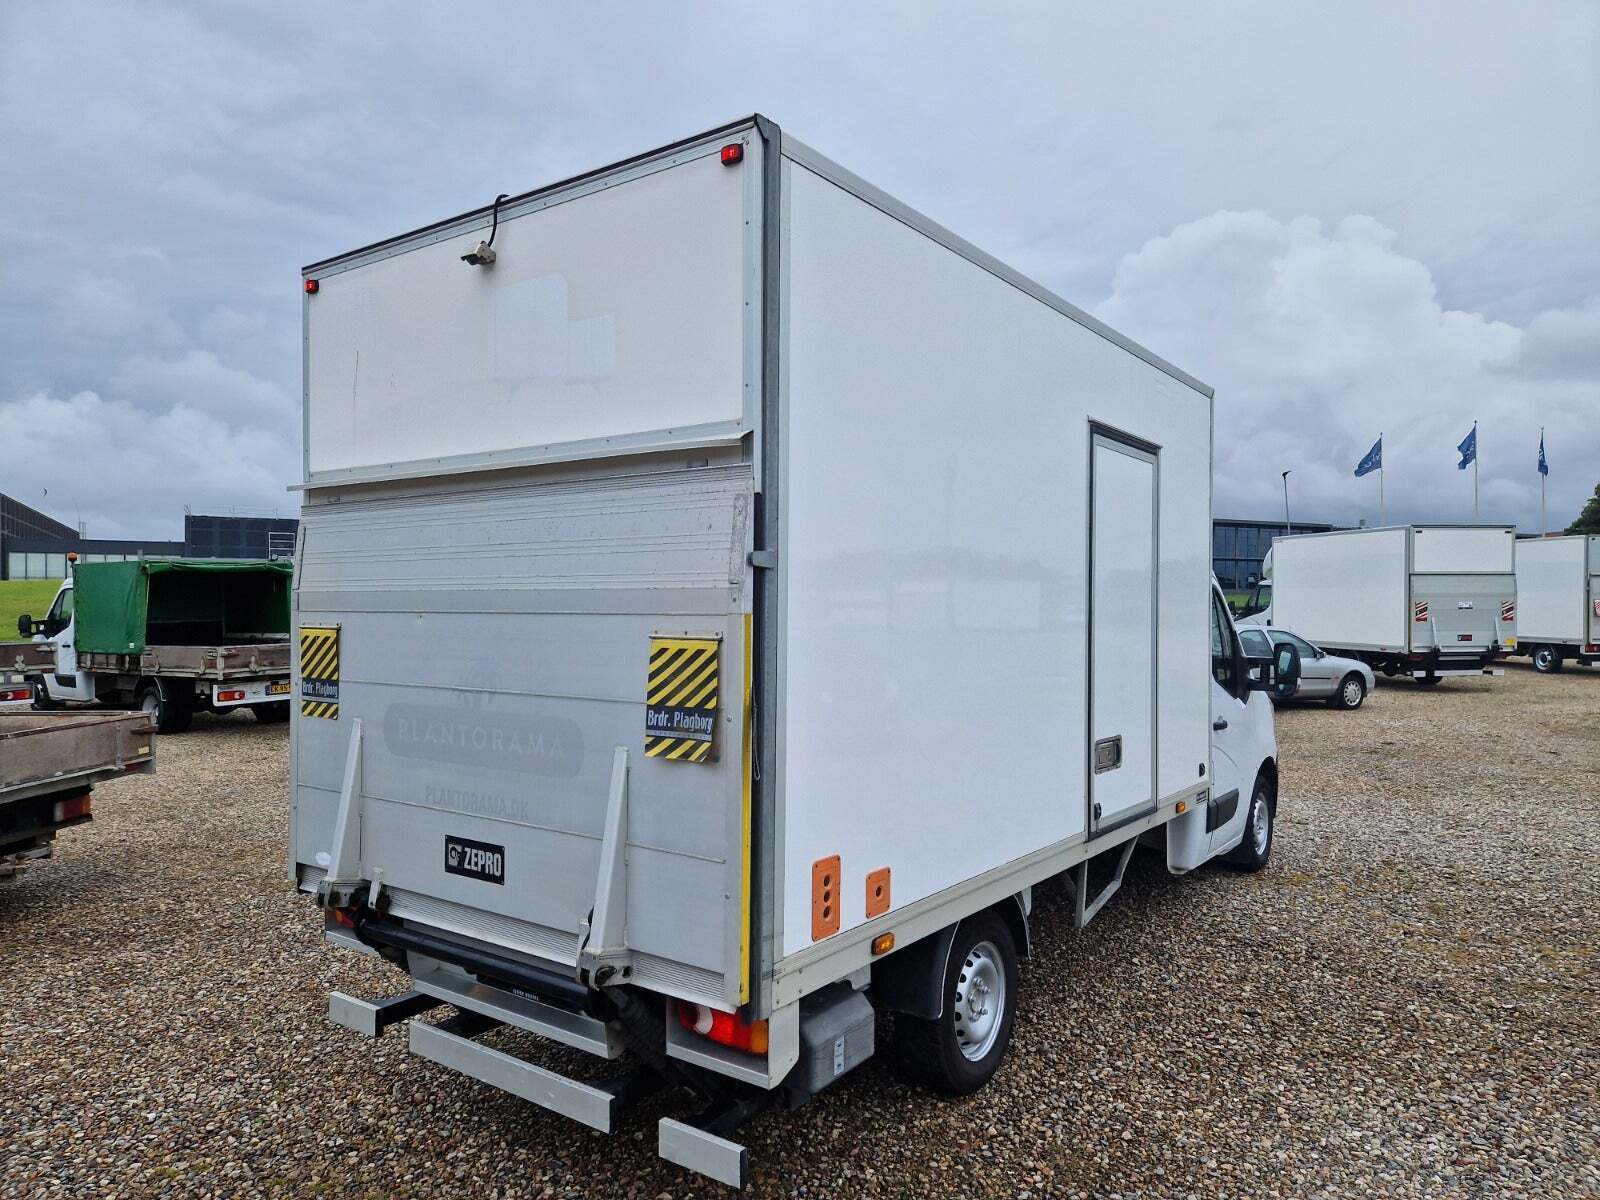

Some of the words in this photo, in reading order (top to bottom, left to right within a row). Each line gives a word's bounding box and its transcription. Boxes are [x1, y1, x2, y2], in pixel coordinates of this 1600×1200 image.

[647, 709, 671, 727] Brdr.
[673, 711, 713, 733] Plagborg
[399, 718, 564, 758] PLANTORAMA
[425, 785, 529, 820] PLANTORAMA.DK
[464, 847, 502, 877] ZEPRO
